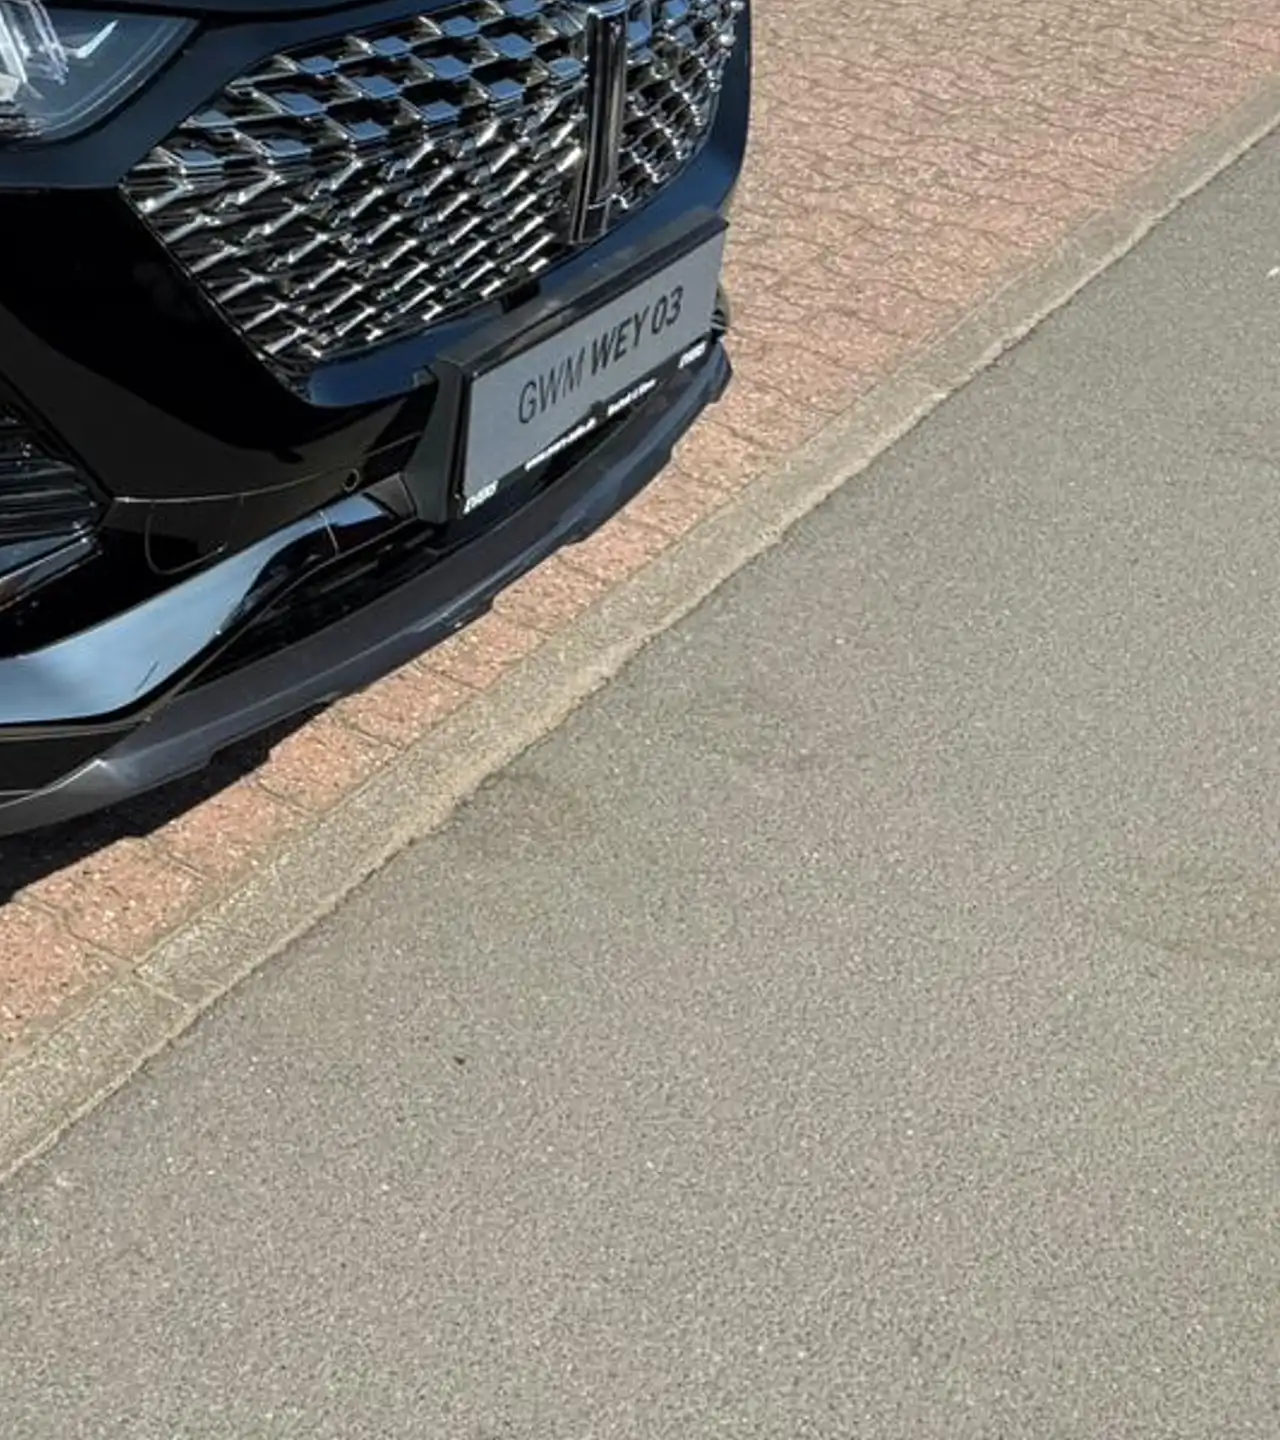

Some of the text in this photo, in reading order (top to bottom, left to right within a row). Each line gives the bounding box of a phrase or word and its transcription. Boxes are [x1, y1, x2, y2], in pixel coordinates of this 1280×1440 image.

[517, 347, 586, 424] GWM
[591, 306, 648, 377] WEY
[650, 285, 684, 335] 03
